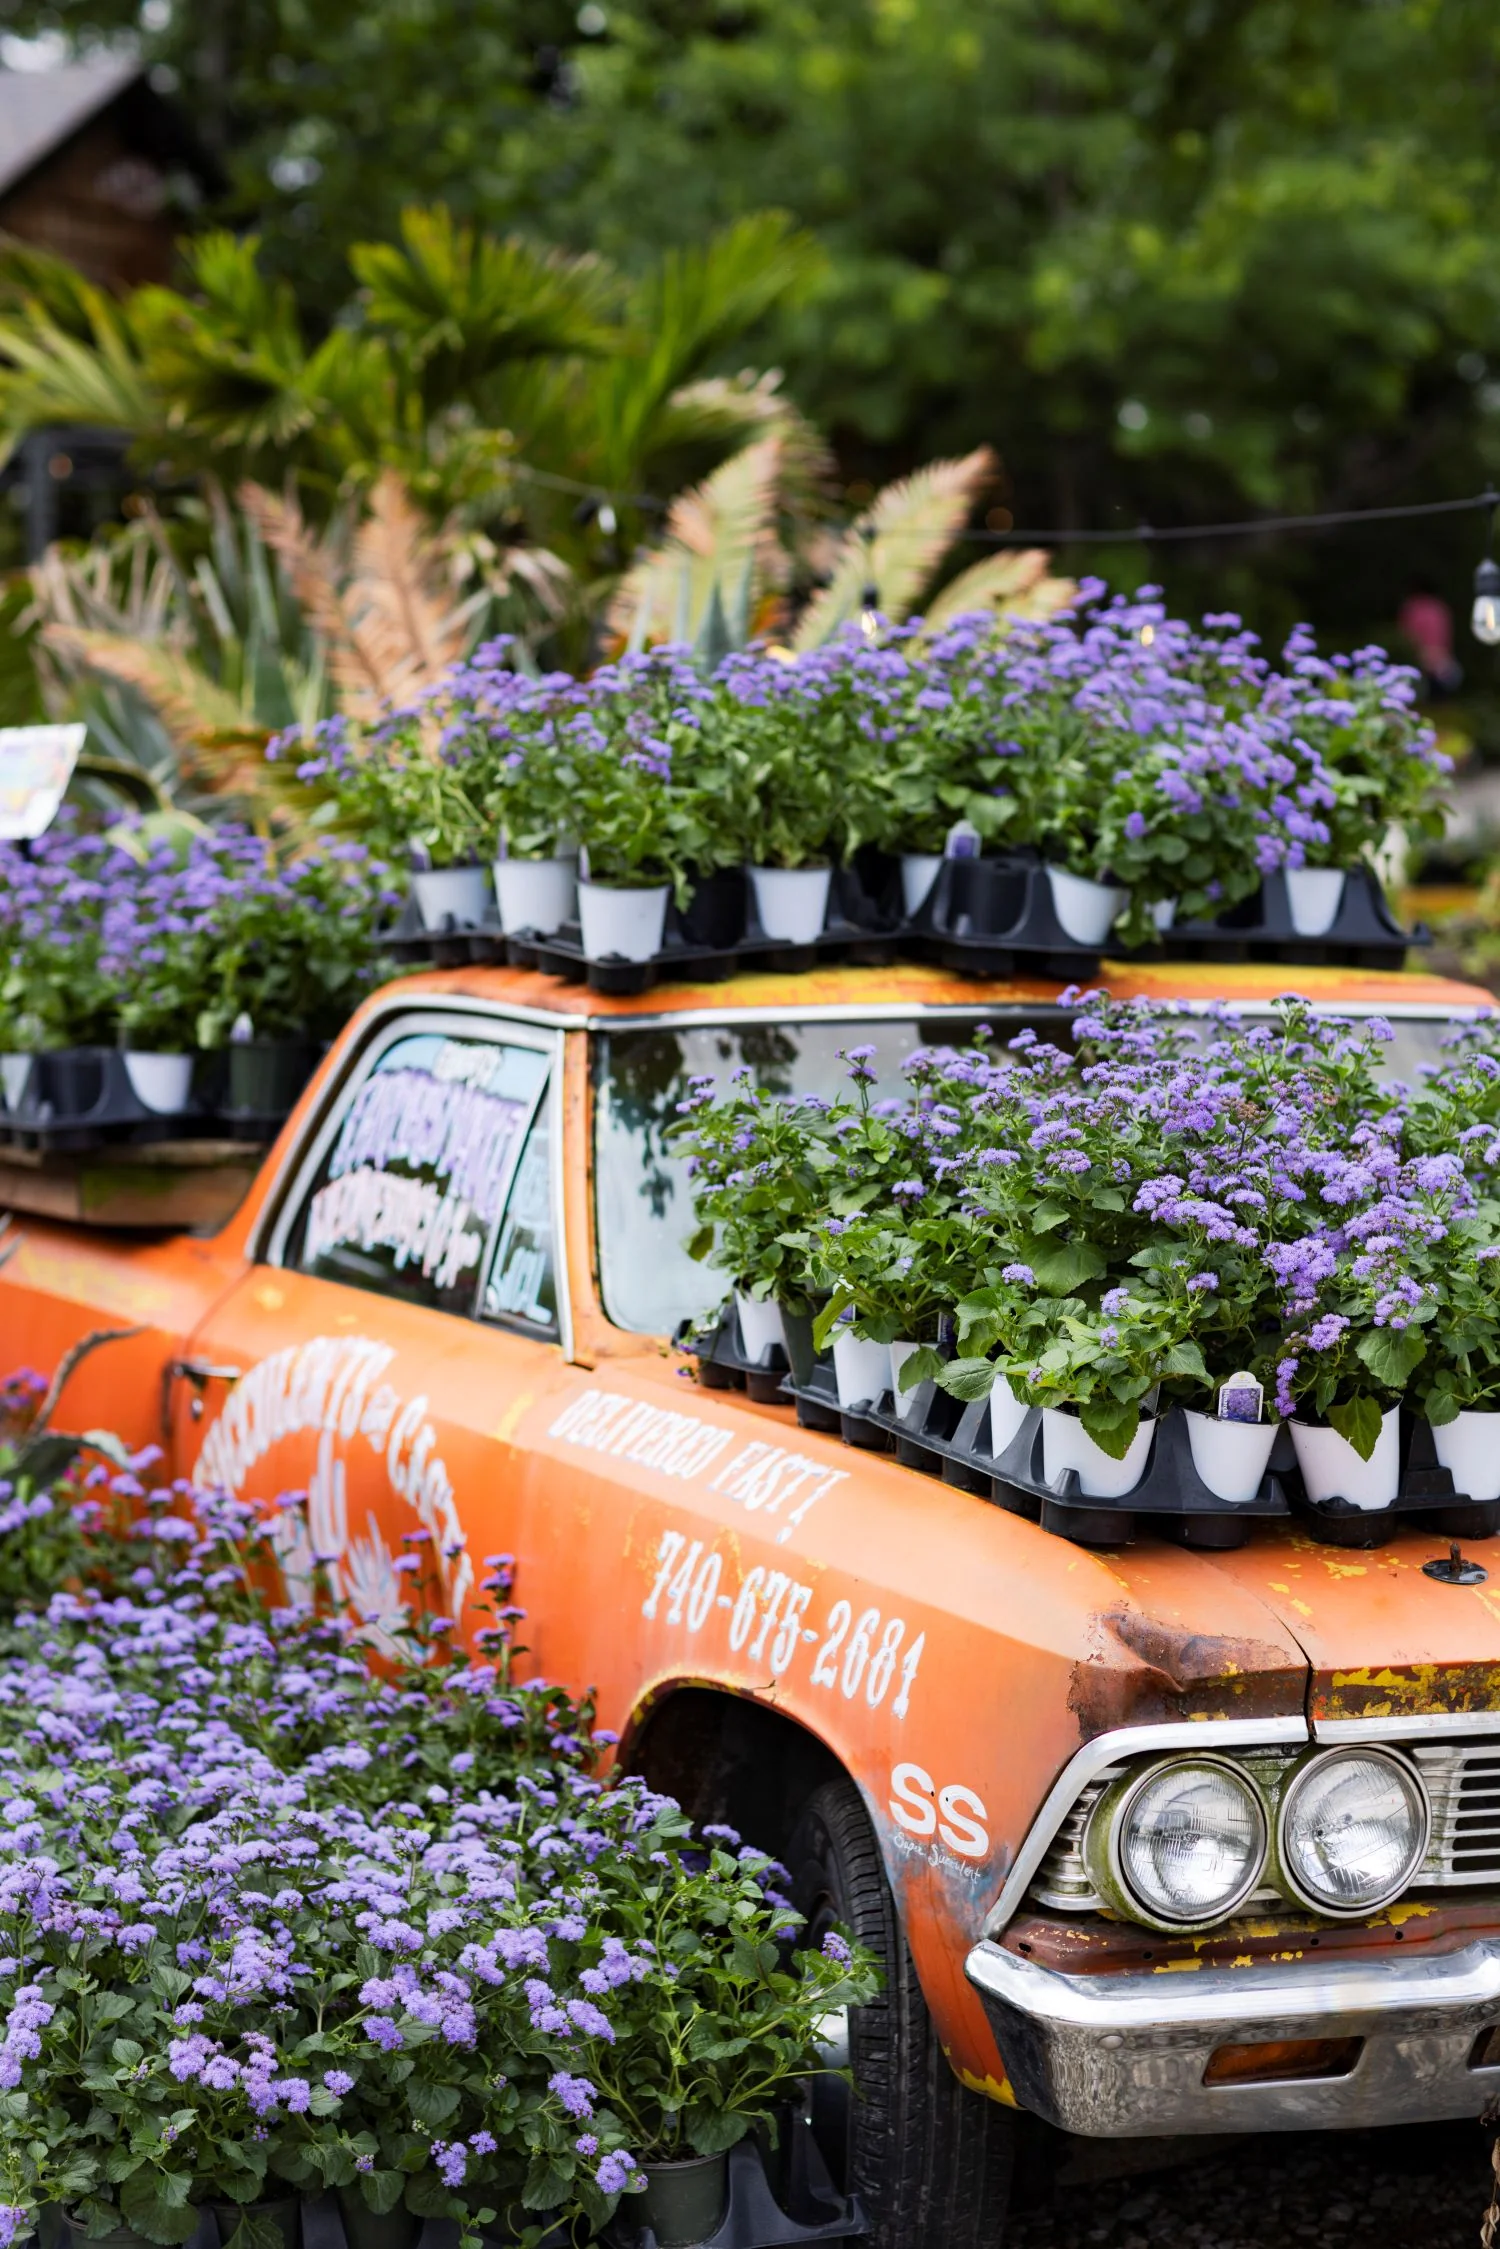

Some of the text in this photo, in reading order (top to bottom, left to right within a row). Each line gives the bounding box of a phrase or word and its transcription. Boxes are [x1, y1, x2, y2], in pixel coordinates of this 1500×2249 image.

[547, 1388, 852, 1545] DELIVERED FAST!
[642, 1529, 926, 1721] 740-675-2681
[888, 1762, 989, 1857] SS
